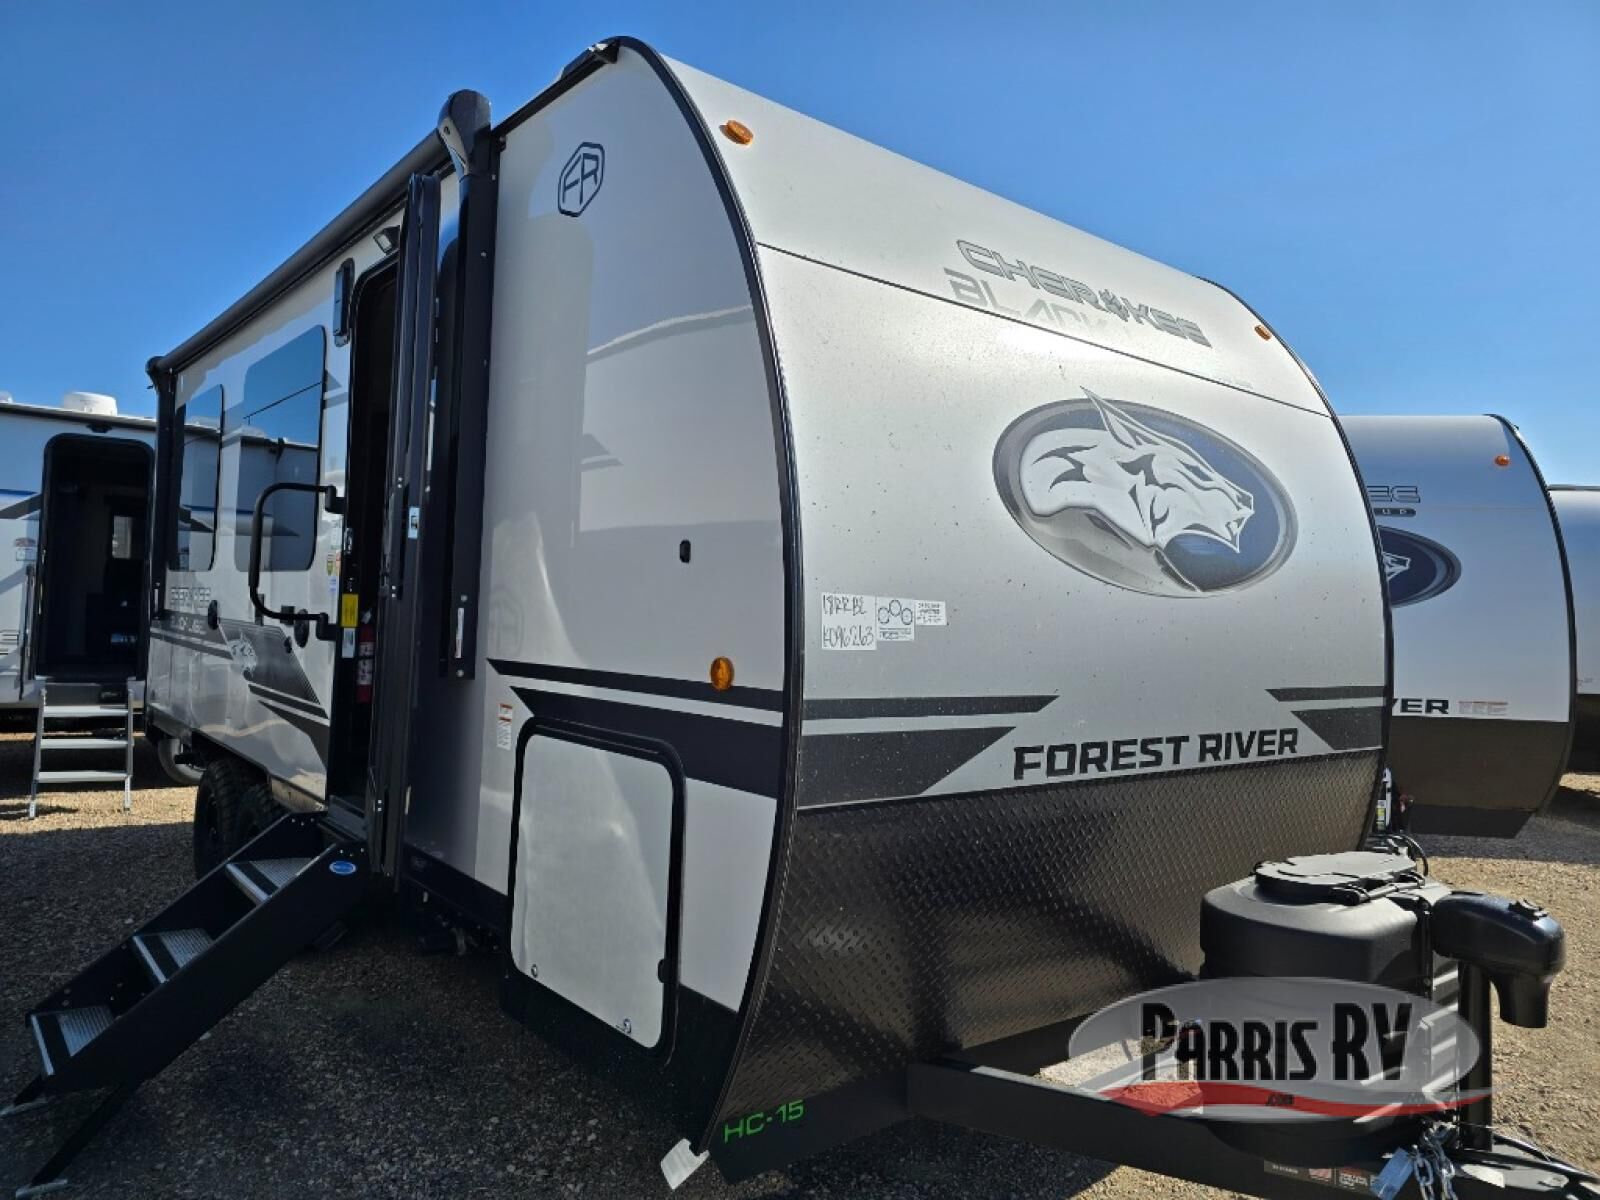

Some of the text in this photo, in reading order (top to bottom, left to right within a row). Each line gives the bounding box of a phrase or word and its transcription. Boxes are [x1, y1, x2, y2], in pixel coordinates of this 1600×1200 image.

[1393, 698, 1450, 714] ER
[1013, 727, 1298, 781] FOREST RIVER
[724, 1099, 805, 1144] HC-15
